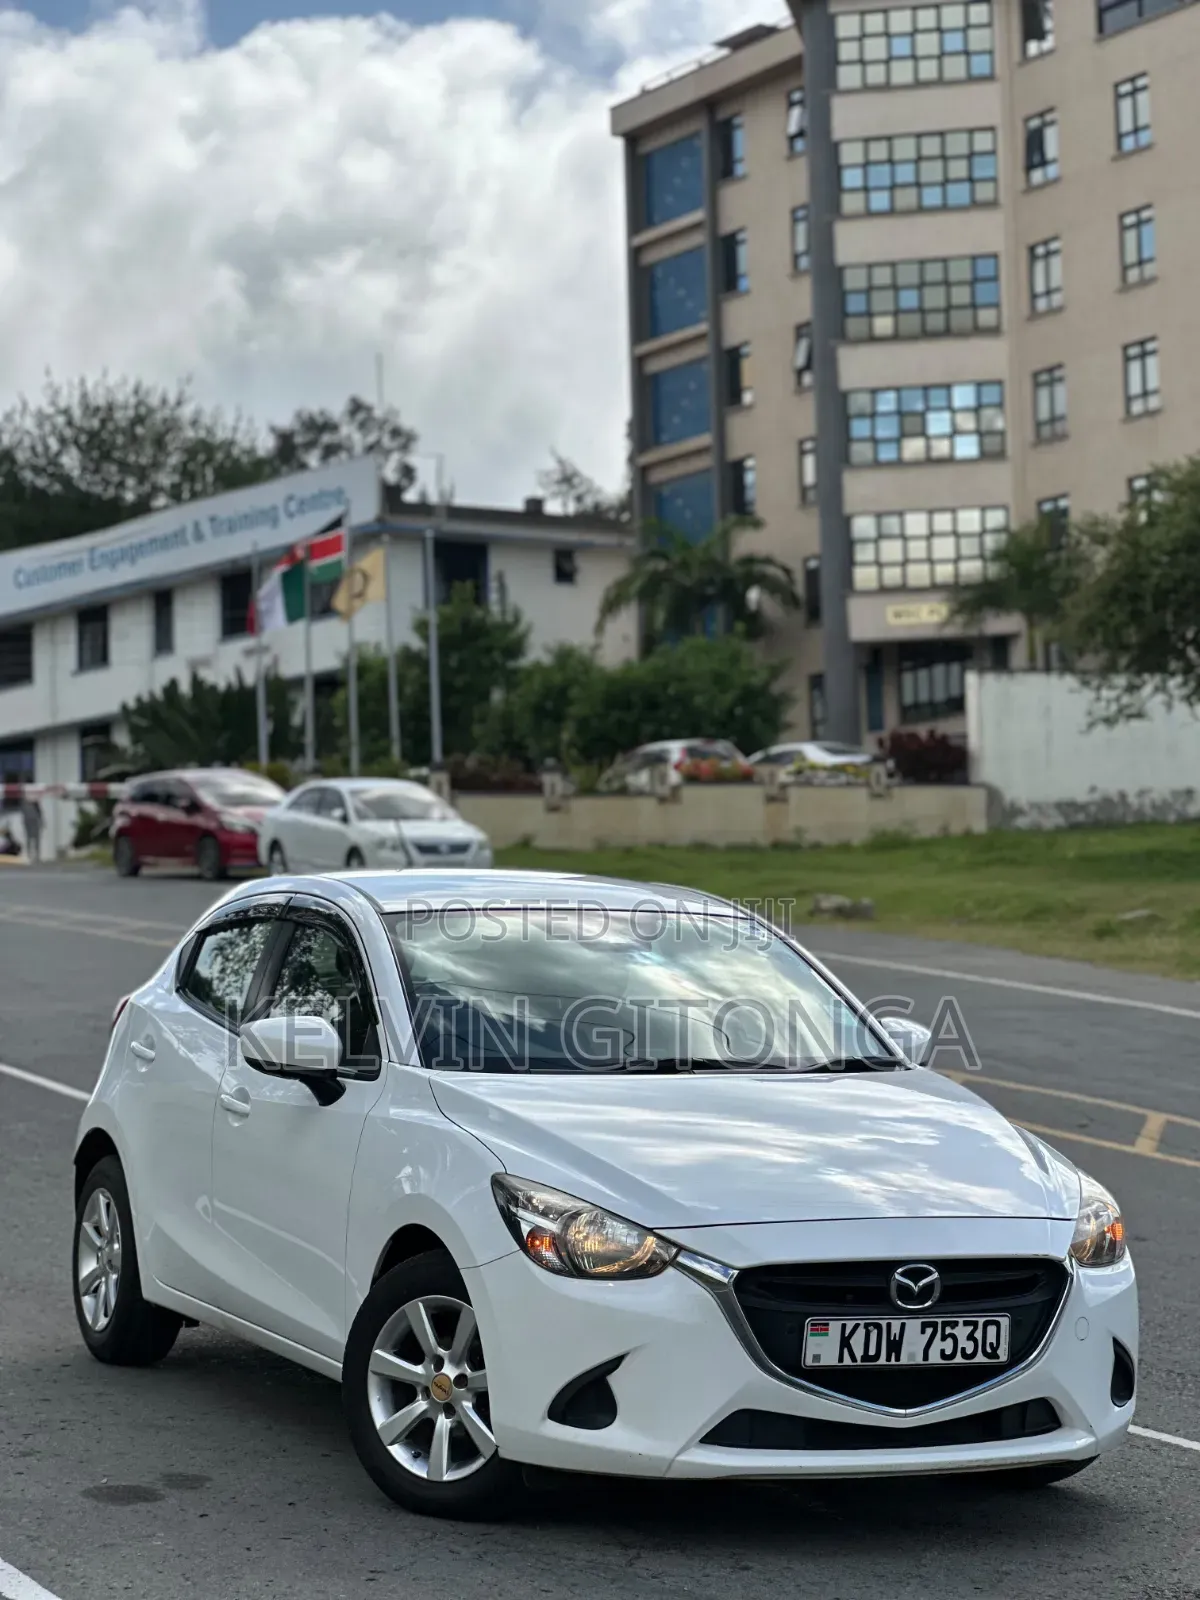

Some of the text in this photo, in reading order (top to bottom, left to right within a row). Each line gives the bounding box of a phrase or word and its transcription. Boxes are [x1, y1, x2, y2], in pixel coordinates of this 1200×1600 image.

[13, 557, 85, 590] Customer
[88, 523, 190, 572] Engagement
[192, 519, 205, 543] &
[208, 503, 280, 538] Training
[837, 1321, 907, 1364] KDW
[920, 1318, 1001, 1362] 753Q
